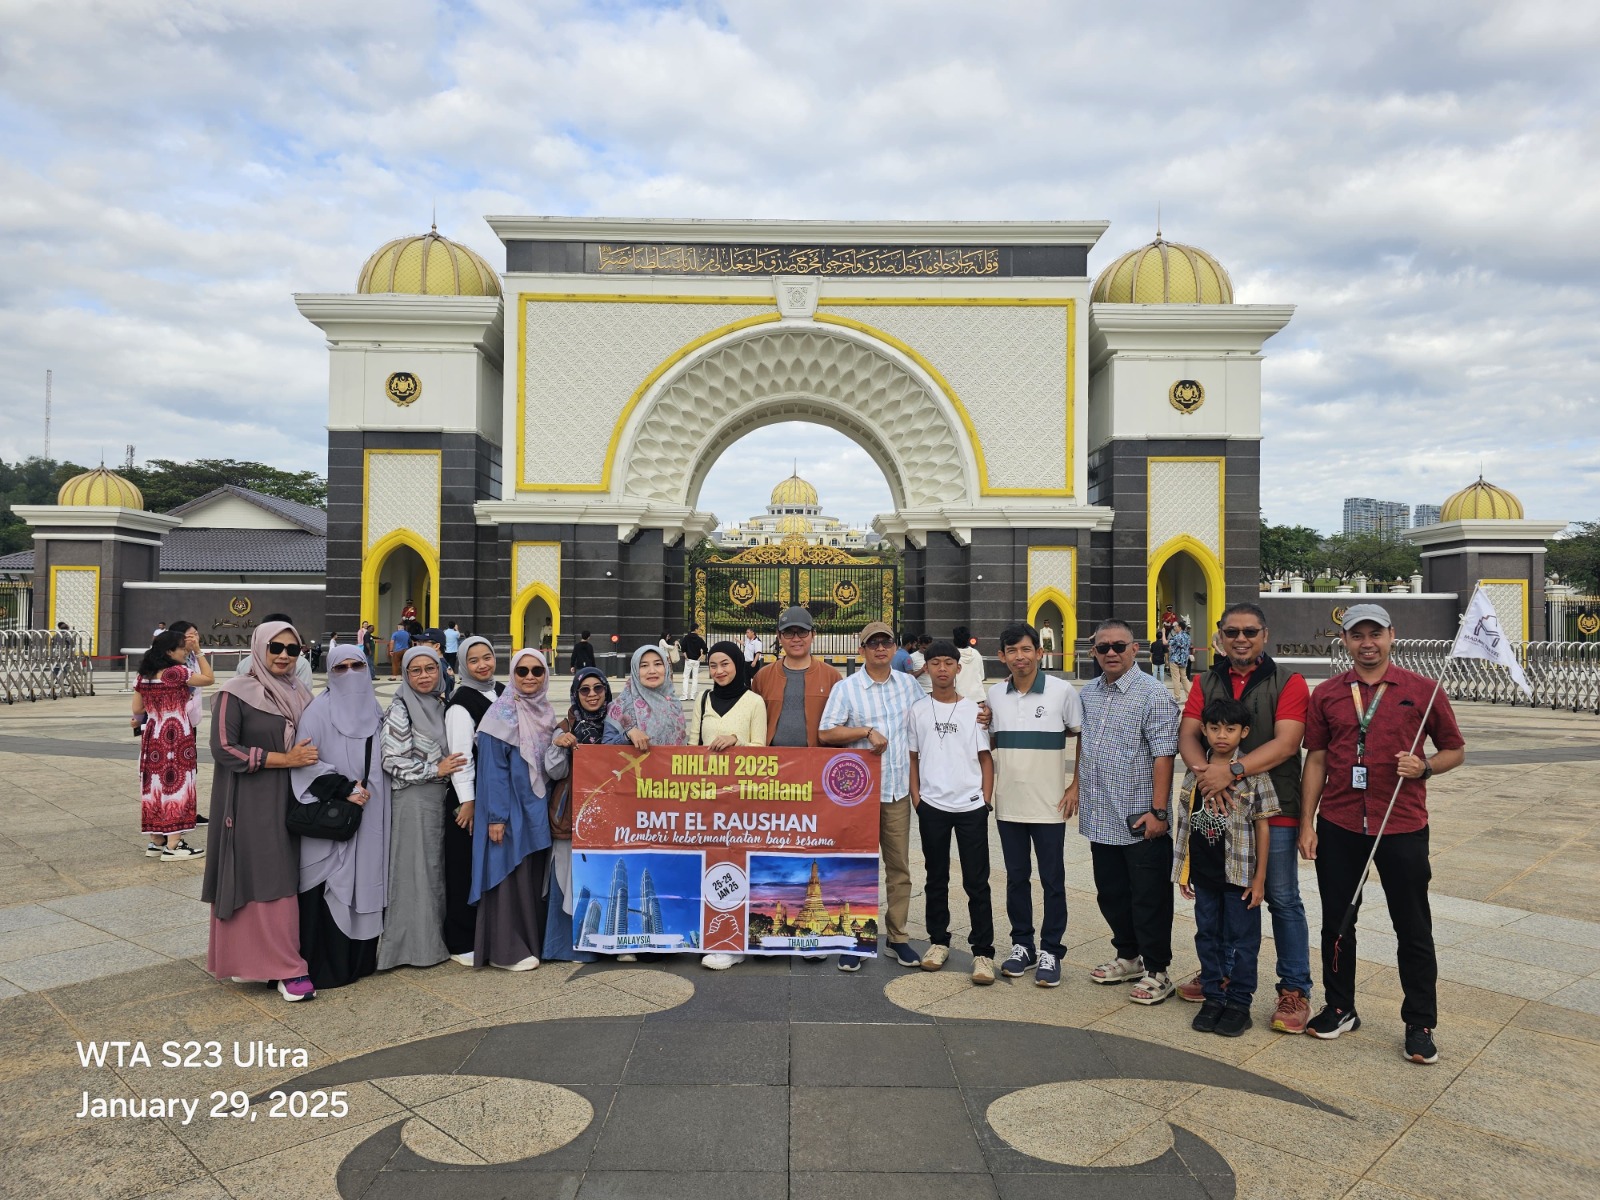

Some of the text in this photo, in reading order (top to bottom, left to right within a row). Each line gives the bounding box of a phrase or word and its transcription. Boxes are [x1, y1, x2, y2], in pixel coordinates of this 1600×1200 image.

[1276, 643, 1332, 657] ISTANA
[671, 754, 779, 777] RIHLAH 2025
[636, 777, 717, 802] Malaysia
[737, 780, 813, 802] Thailand
[636, 811, 817, 833] BMT EL RAUSHAN
[614, 825, 836, 849] Memberi kebermanfaatan bagi sesama
[712, 872, 733, 891] 25-29
[717, 881, 739, 901] JAN 25
[617, 935, 651, 945] MALAYSIA
[787, 937, 819, 948] THAILAND
